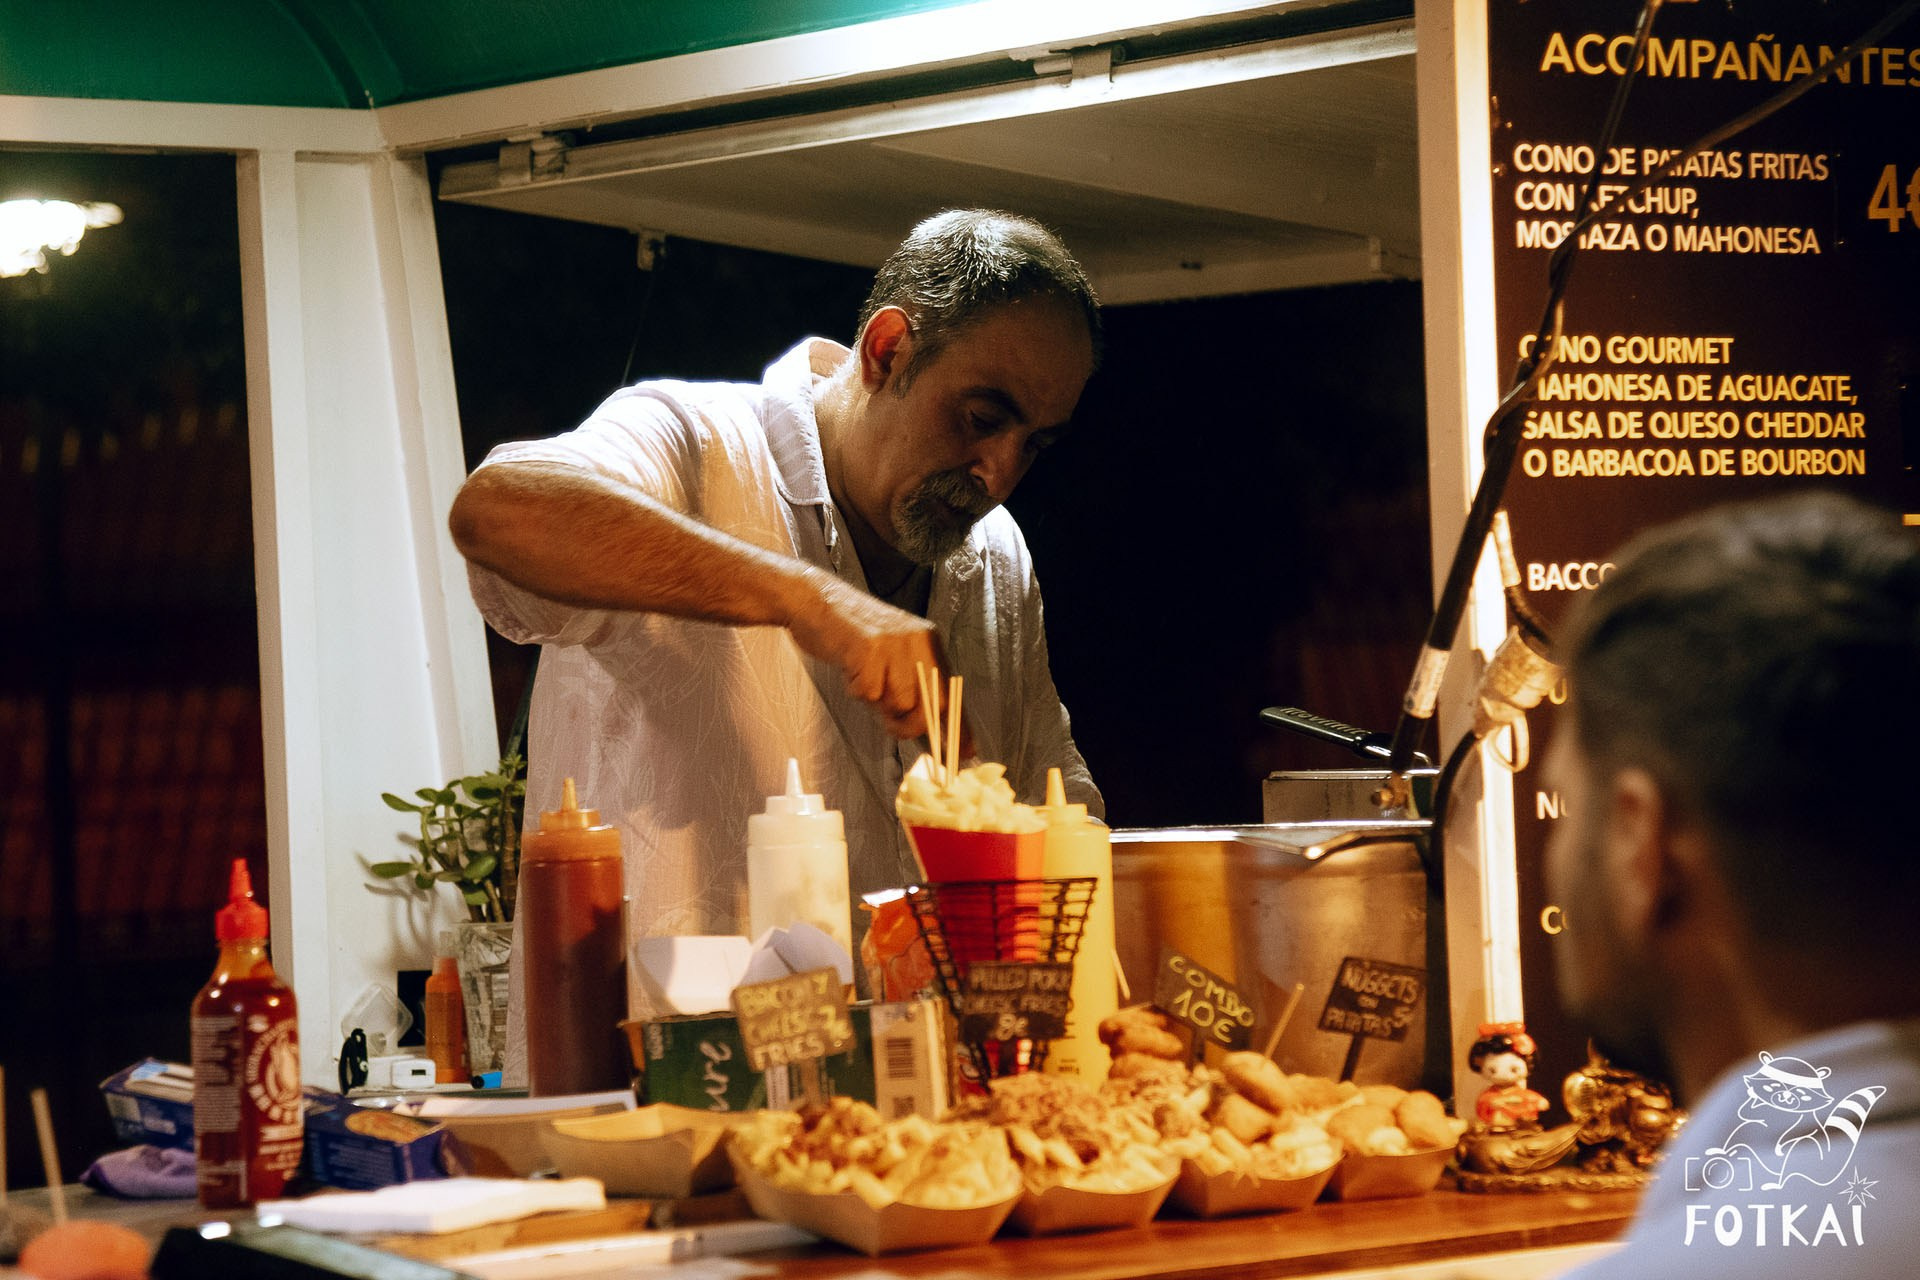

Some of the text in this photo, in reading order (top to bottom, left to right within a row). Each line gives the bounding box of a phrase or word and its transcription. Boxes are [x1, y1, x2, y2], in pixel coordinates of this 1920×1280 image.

[1514, 143, 1595, 174] CONO
[1602, 147, 1637, 176] DE
[1749, 152, 1829, 181] FRITAS
[1515, 181, 1575, 211] CON
[1645, 223, 1668, 252] O
[1674, 224, 1821, 254] MAHONESA
[1518, 334, 1735, 364] CNO GOURMET
[1677, 374, 1713, 402] DE
[1718, 374, 1858, 406] AGUACATE,
[1522, 410, 1866, 439] SALSA DE QUESO CHEDDAR
[1522, 448, 1866, 478] O BARBACOA DE BOURBON
[1168, 955, 1256, 1028] COMBO
